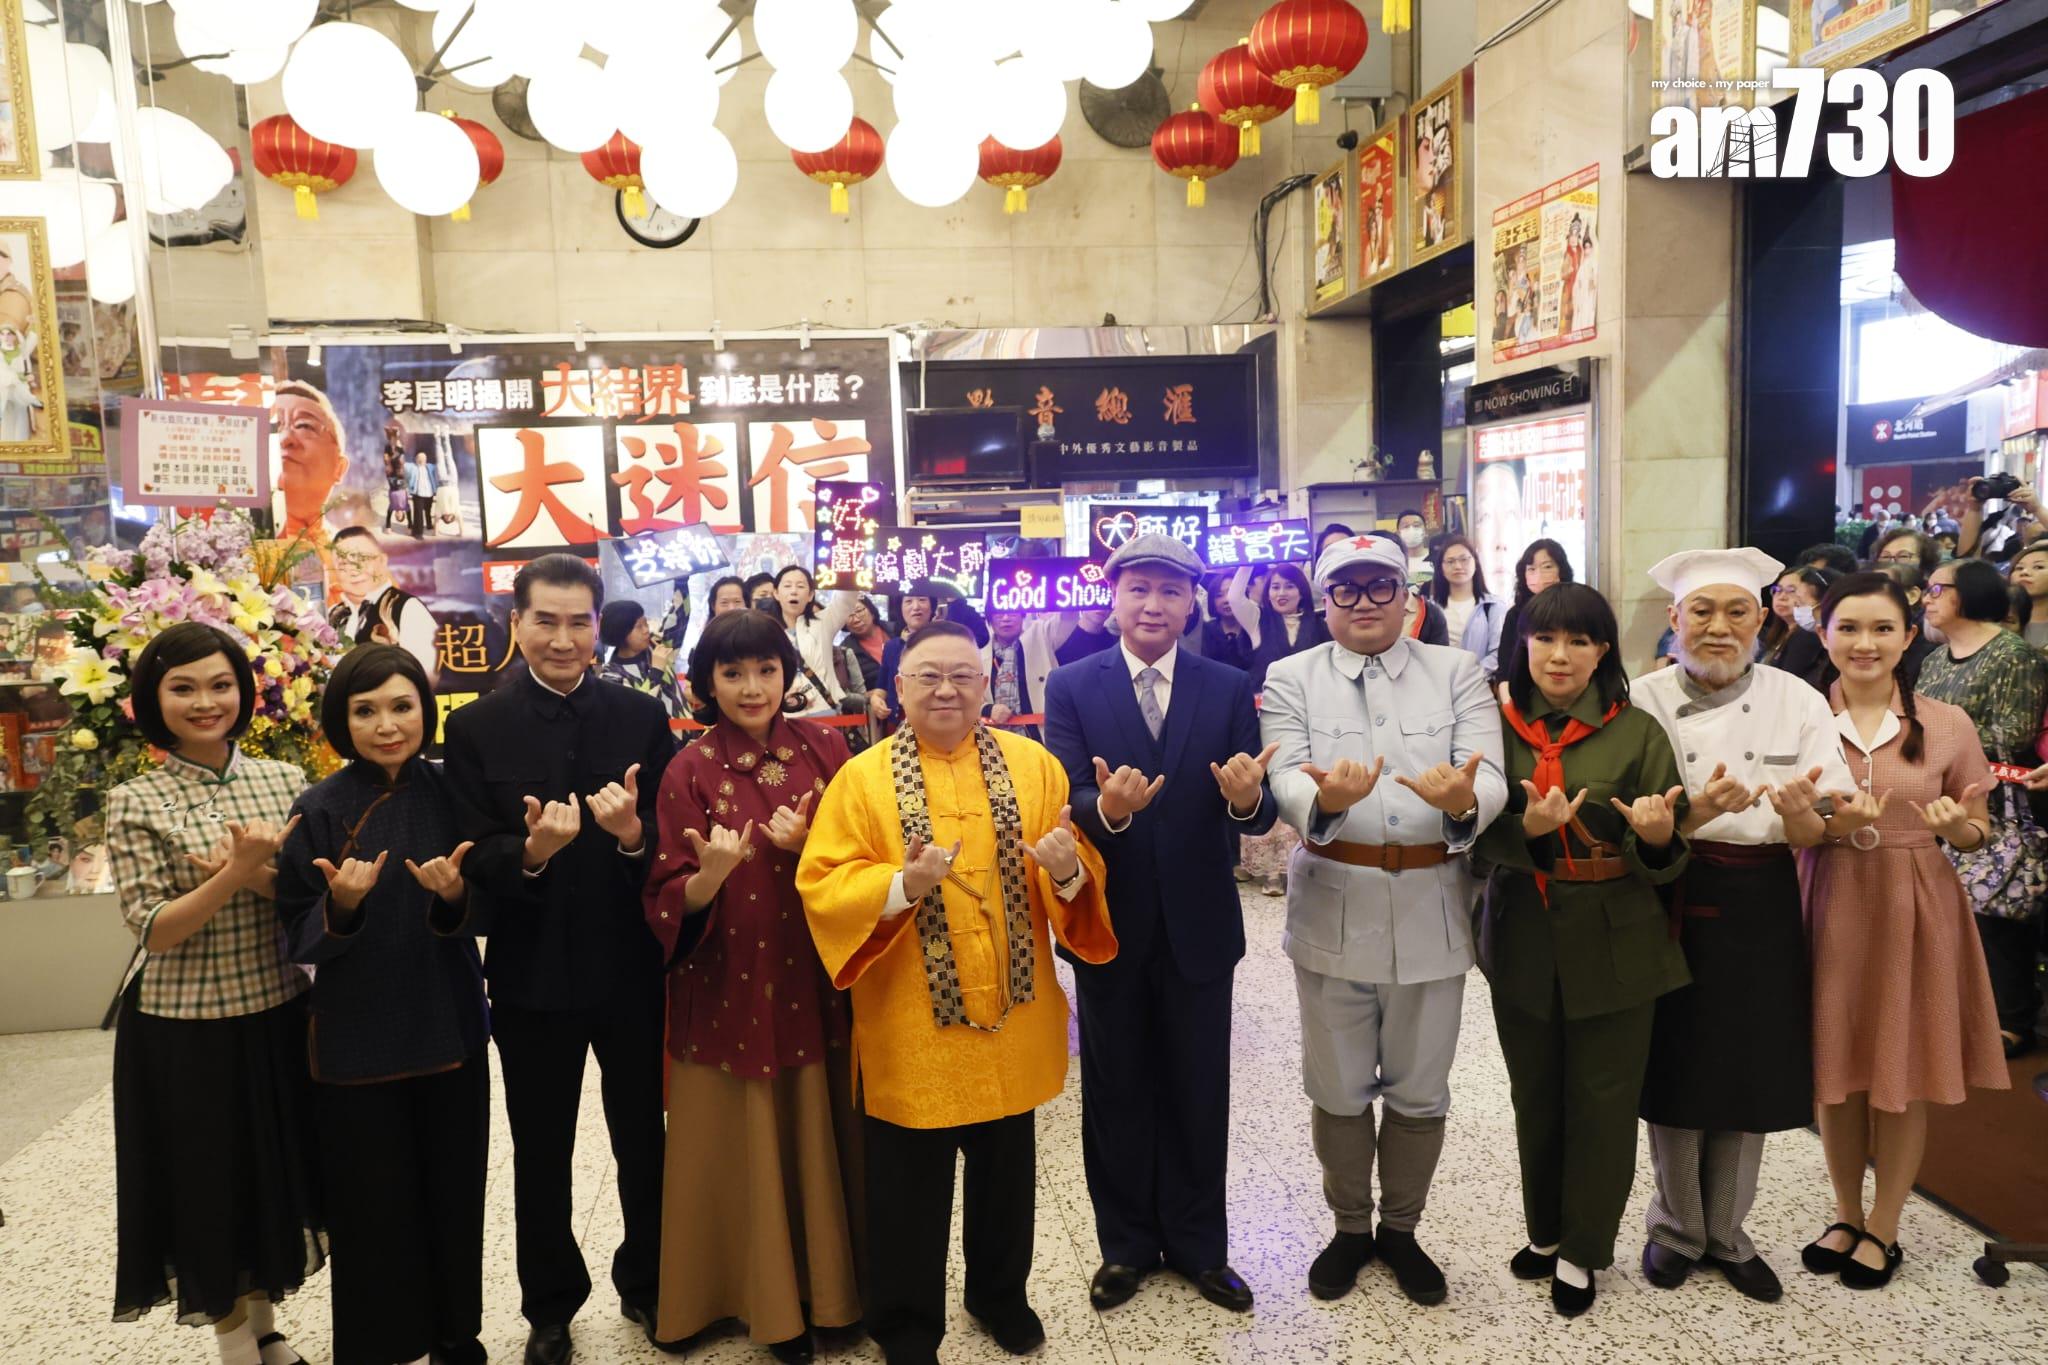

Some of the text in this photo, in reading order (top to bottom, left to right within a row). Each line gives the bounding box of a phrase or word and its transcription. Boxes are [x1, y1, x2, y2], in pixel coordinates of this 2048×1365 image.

[383, 378, 534, 413] 李居明揭開
[540, 362, 696, 423] 大結界
[1484, 394, 1509, 410] NOW
[1509, 381, 1561, 406] SHOWING
[991, 573, 1113, 612] Good Show
